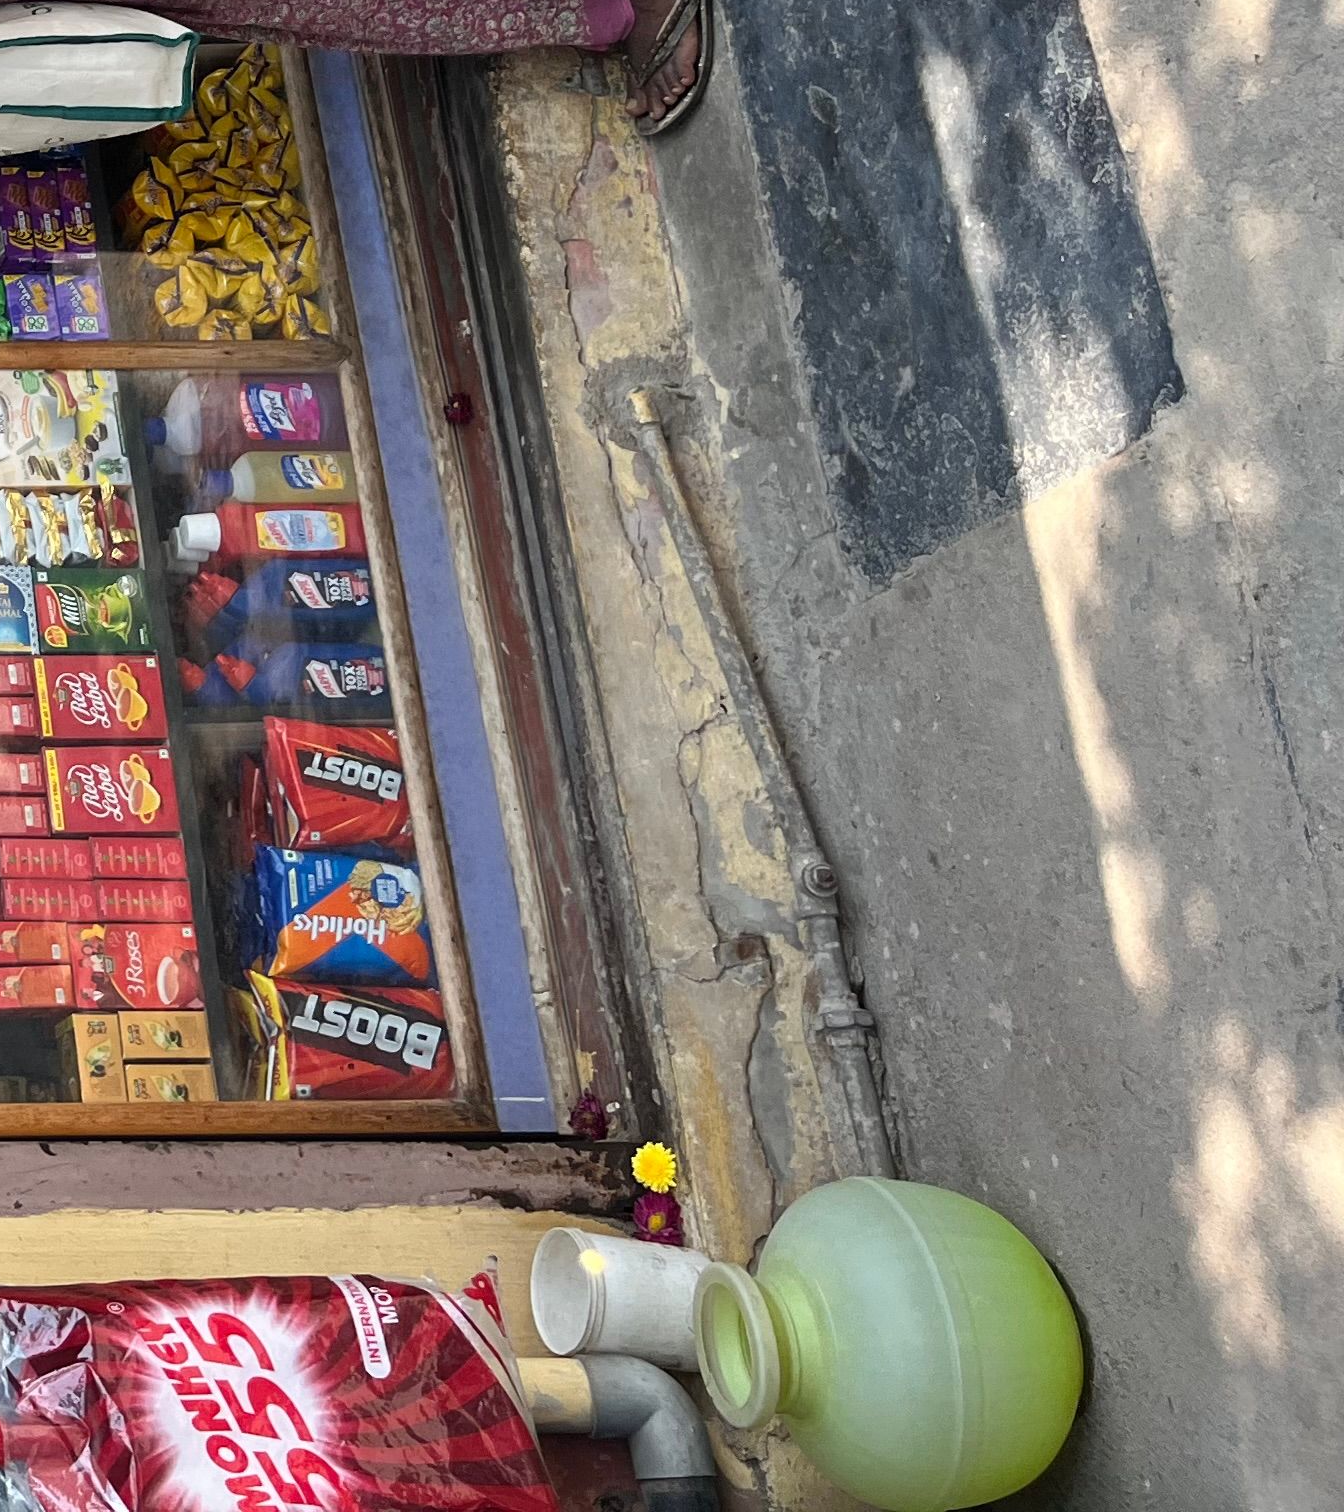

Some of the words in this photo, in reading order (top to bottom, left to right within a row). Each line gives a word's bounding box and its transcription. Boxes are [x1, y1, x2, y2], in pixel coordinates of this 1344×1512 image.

[296, 579, 322, 606] HARPIC
[328, 576, 341, 601] 10X
[314, 667, 337, 696] HARPIC
[345, 665, 357, 690] 10X
[63, 679, 90, 716] Red
[78, 672, 111, 728] Label
[72, 769, 102, 808] Red
[91, 764, 123, 821] Label
[303, 750, 403, 801] BOOST
[293, 913, 386, 944] Horlicks
[123, 931, 145, 982] Roses
[126, 983, 146, 997] 3
[291, 993, 443, 1070] BOOST
[371, 1287, 400, 1323] MOP
[132, 1315, 277, 1512] MONKEY
[177, 1312, 345, 1509] 555
